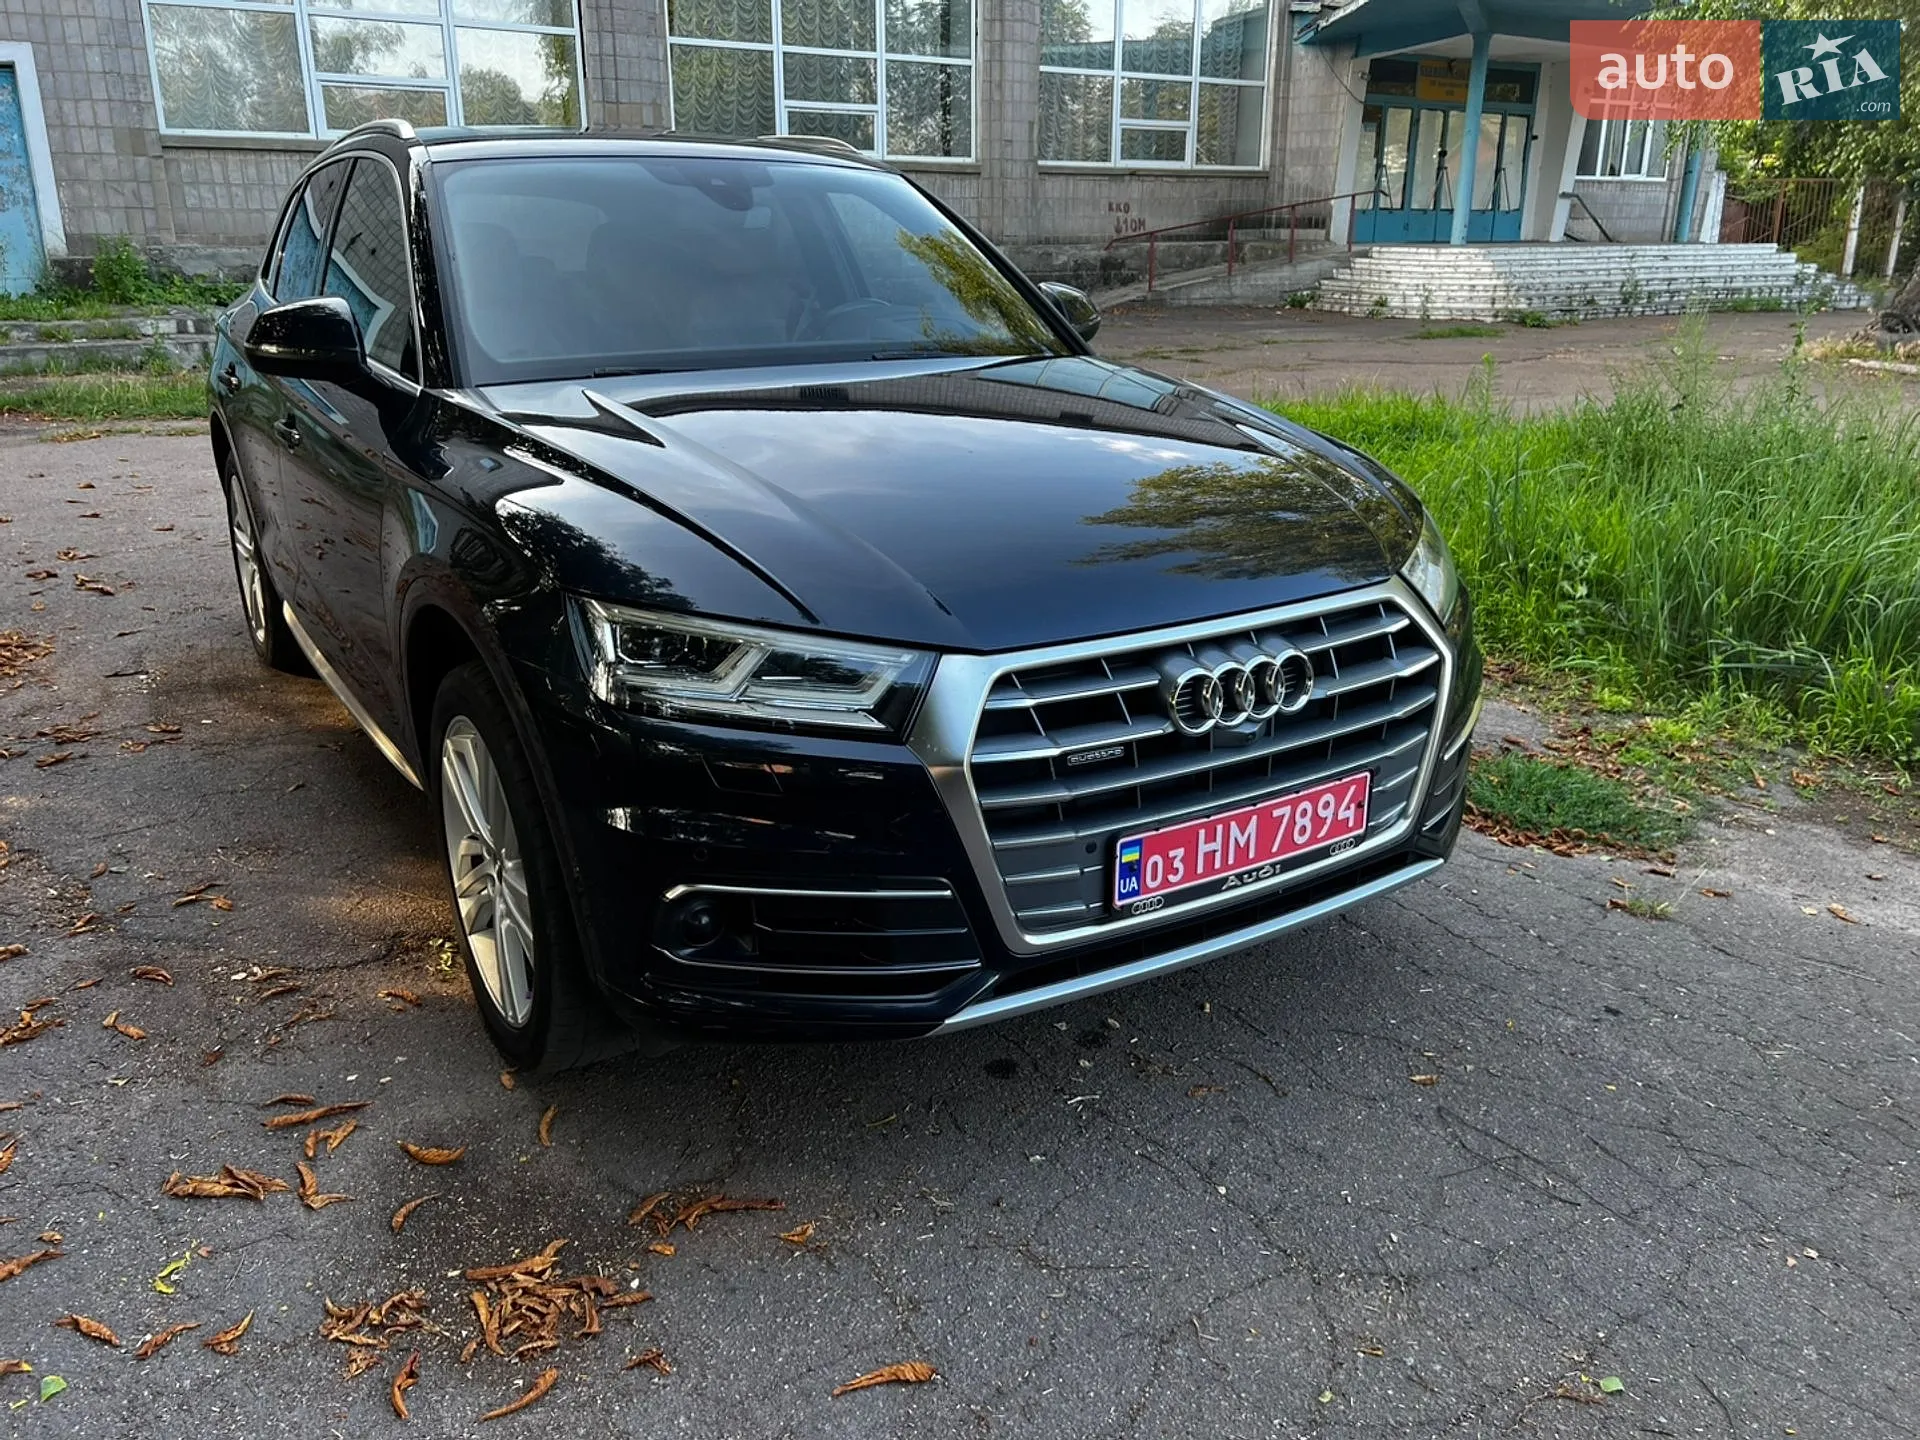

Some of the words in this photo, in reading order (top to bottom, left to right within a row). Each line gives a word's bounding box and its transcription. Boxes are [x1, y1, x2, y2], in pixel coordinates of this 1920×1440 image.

[1145, 847, 1184, 889] 03
[1197, 815, 1258, 875] HM
[1271, 785, 1356, 852] 7894
[1119, 879, 1138, 893] UA
